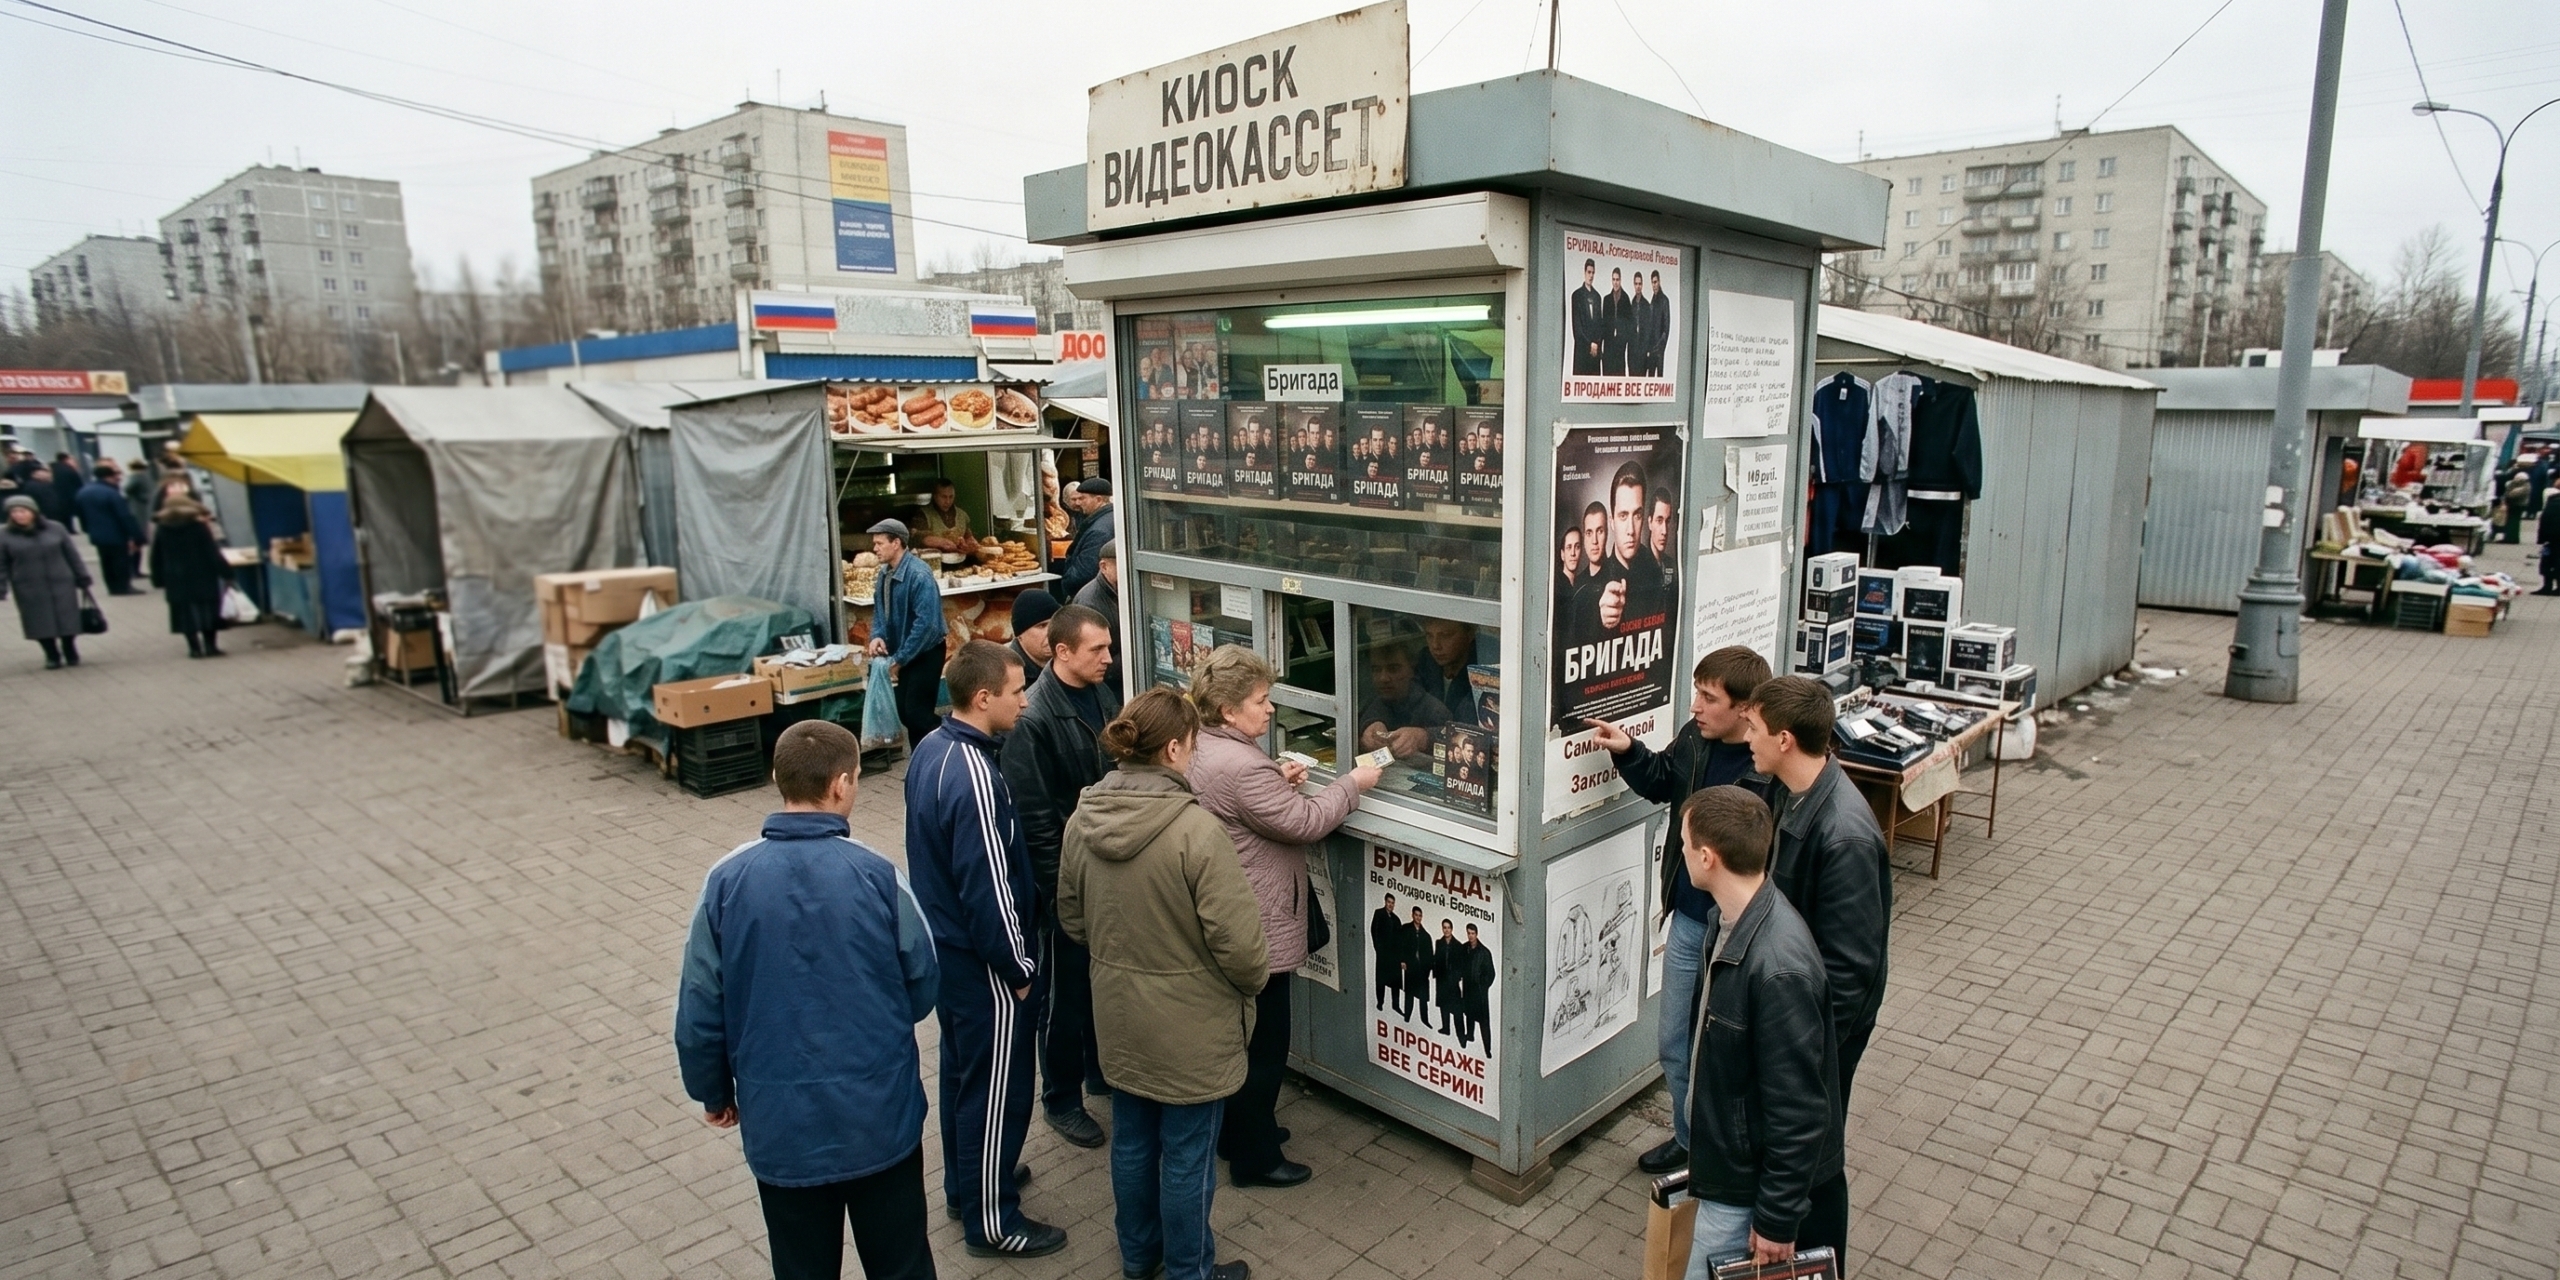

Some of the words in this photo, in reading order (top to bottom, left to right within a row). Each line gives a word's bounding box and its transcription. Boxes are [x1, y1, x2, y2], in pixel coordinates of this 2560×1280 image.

[1161, 44, 1299, 128] КИОСК
[1104, 95, 1378, 209] ВИДЕОКАССЕТ
[1267, 367, 1339, 397] Бригада
[1564, 381, 1571, 397] В
[1624, 382, 1642, 397] ВСЕ
[1564, 628, 1663, 684] БРИГАДА
[1373, 845, 1491, 903] БРИГАДА:
[1377, 1019, 1388, 1038] В
[1393, 1026, 1485, 1080] ПРОДАЖЕ
[1377, 1042, 1411, 1073] ВЕЕ
[1417, 1061, 1484, 1105] СЕРИИ!
